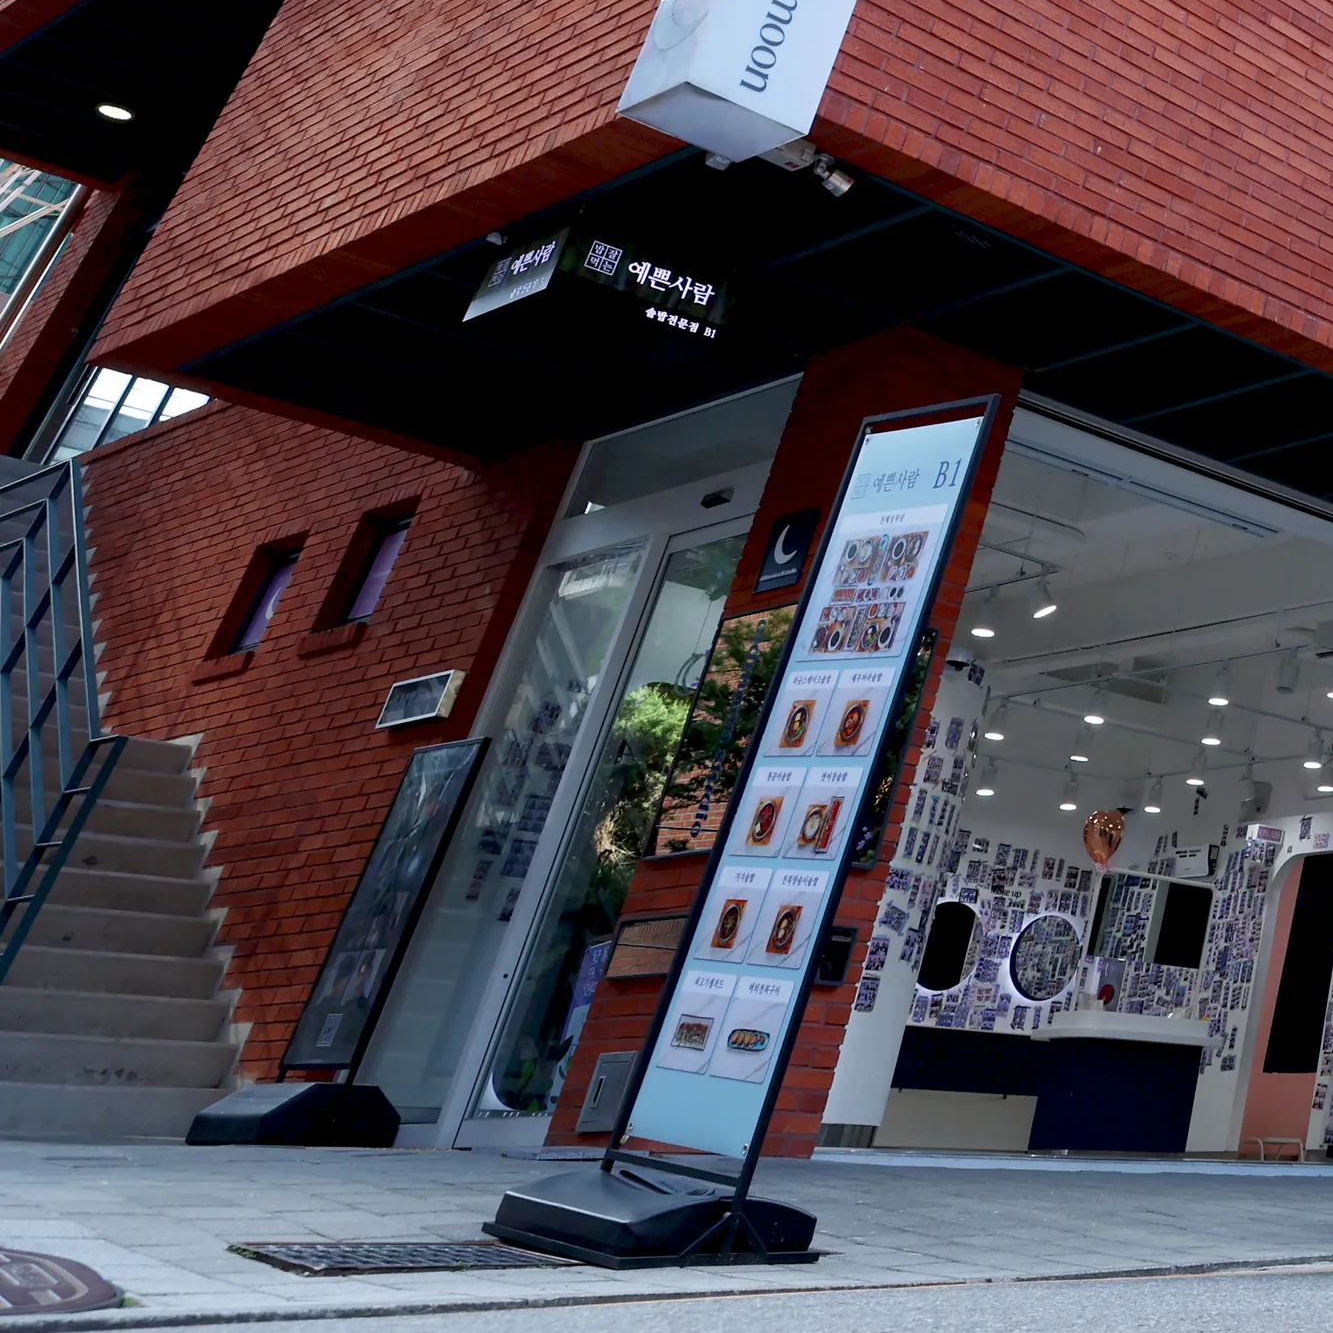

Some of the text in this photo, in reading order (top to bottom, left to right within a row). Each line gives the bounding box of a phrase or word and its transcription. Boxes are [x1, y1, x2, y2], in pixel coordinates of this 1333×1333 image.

[628, 261, 715, 306] 예쁜사람
[703, 326, 717, 338] B1
[873, 468, 920, 494] 예쁜사람
[931, 458, 963, 490] B1
